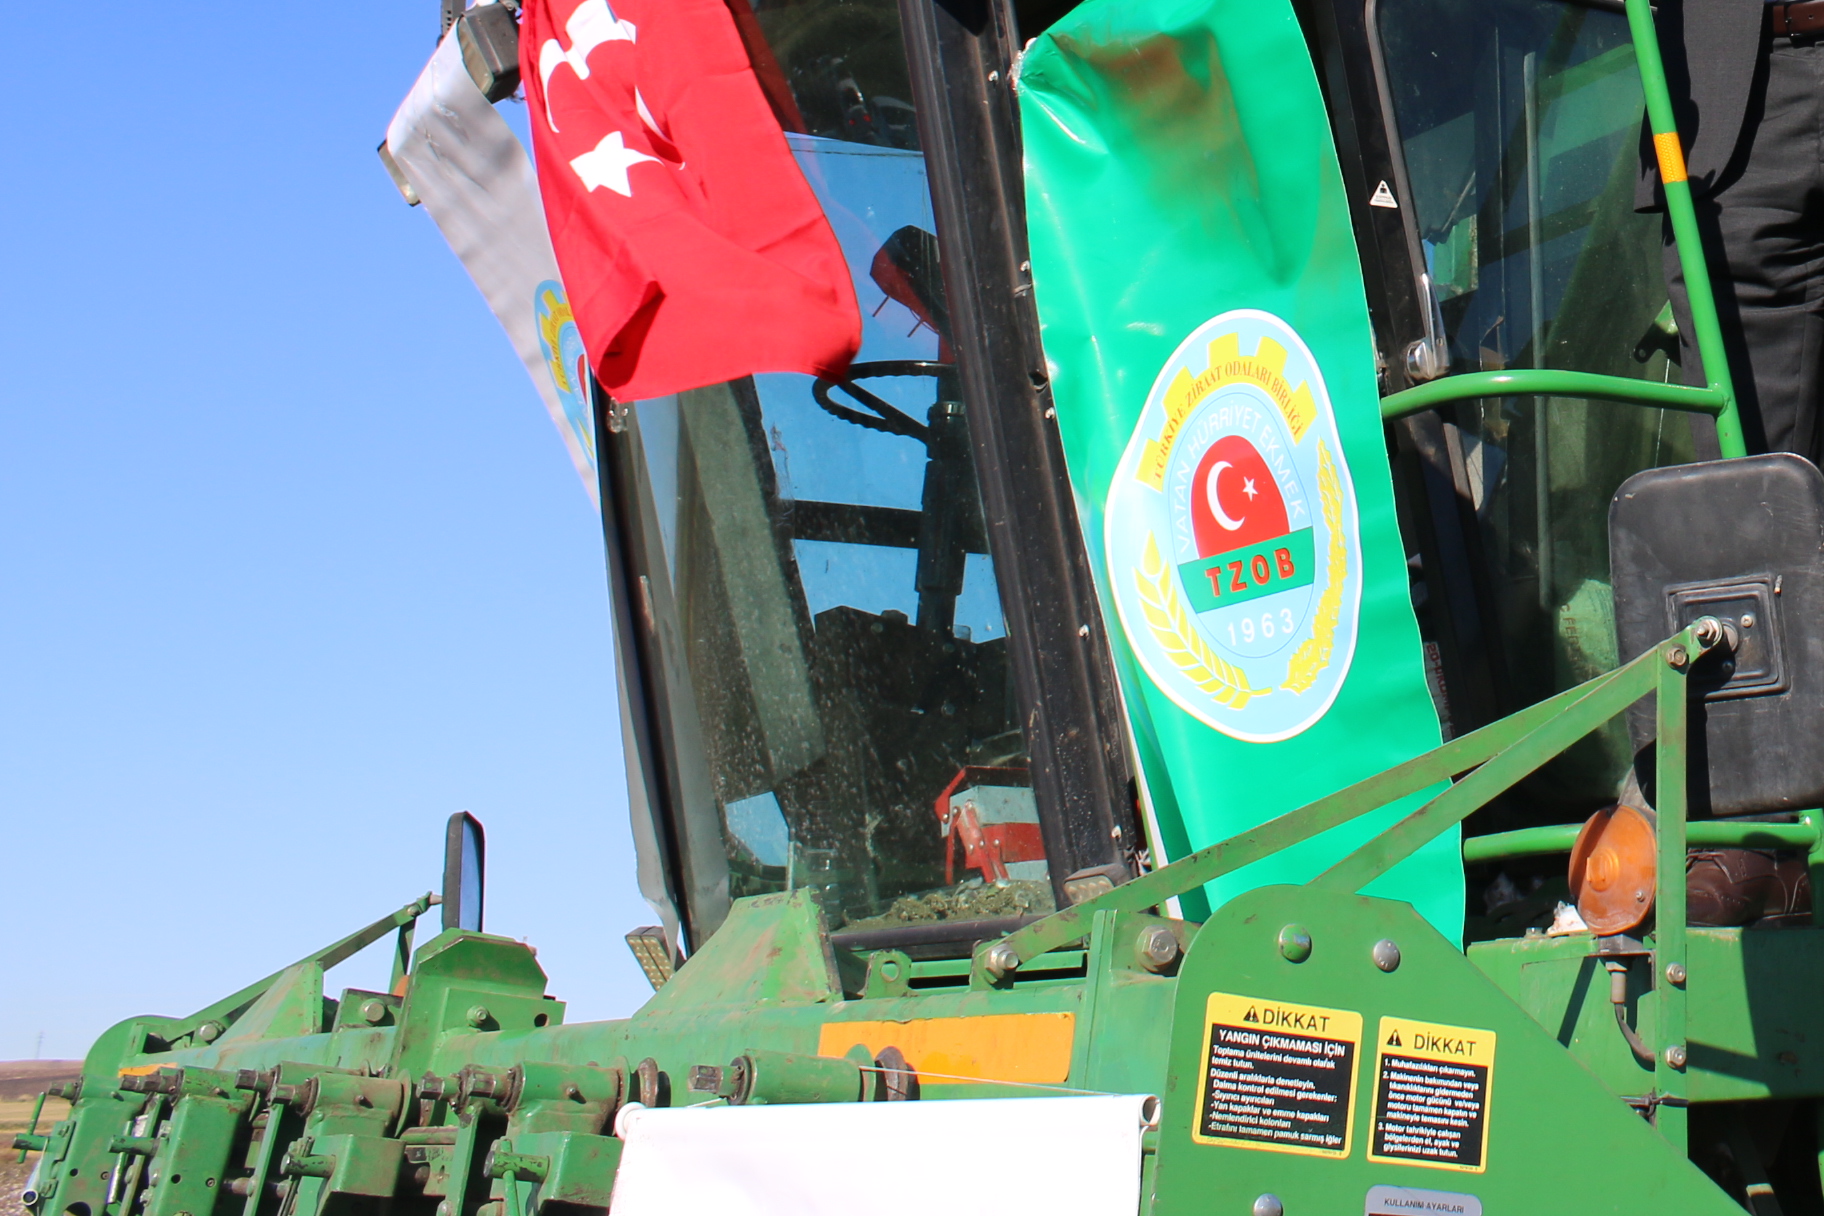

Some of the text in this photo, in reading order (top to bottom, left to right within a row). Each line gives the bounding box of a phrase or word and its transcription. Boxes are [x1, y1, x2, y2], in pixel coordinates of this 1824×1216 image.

[1154, 360, 1304, 481] TÜRKİYE ZİRAAT ODALARI BİRLİĞİ
[1174, 399, 1306, 554] VATAN HÜRRİYET EKMEK
[1204, 547, 1296, 598] TZOB
[1227, 607, 1295, 647] 1963
[1263, 1007, 1330, 1032] DİKKAT
[1220, 1030, 1345, 1059] YANGIN ÇIKMAMASI İÇİN
[1414, 1034, 1476, 1056] DİKKAT
[1212, 1056, 1254, 1069] temiz tutun.
[1213, 1045, 1335, 1068] Toplama ünitelerini devamlı olarak
[1385, 1058, 1390, 1066] 1.
[1211, 1068, 1238, 1078] Düzenli
[1275, 1077, 1315, 1090] denetleyin.
[1213, 1079, 1236, 1090] Daima
[1238, 1082, 1264, 1093] kontrol
[1264, 1087, 1295, 1096] edilmesi
[1390, 1071, 1424, 1084] Makinenin
[1464, 1082, 1478, 1091] veya
[1212, 1090, 1239, 1101] -Sıyırıcı
[1388, 1091, 1479, 1110] önce motor gücünü ve/veya
[1434, 1088, 1473, 1100] gidermeden
[1210, 1112, 1291, 1128] -Nemlendirici kolonları
[1211, 1100, 1329, 1122] -Yan kapaklar ve emme kapakları
[1387, 1111, 1420, 1122] makineyle
[1450, 1118, 1469, 1127] kesin.
[1388, 1102, 1411, 1111] motoru
[1413, 1104, 1443, 1114] tamamen
[1444, 1107, 1467, 1119] kapatın
[1209, 1119, 1341, 1145] -Etrafını tamamen pamuk sarmış iğler
[1378, 1122, 1460, 1140] 3. Motor tahrikiyle çalışan
[1385, 1132, 1423, 1146] bölgelerden
[1434, 1139, 1450, 1149] ayak
[1384, 1142, 1421, 1153] giysilerinizi
[1439, 1149, 1457, 1157] tutun.
[1384, 1197, 1464, 1213] KULLANIM AYARLARI
